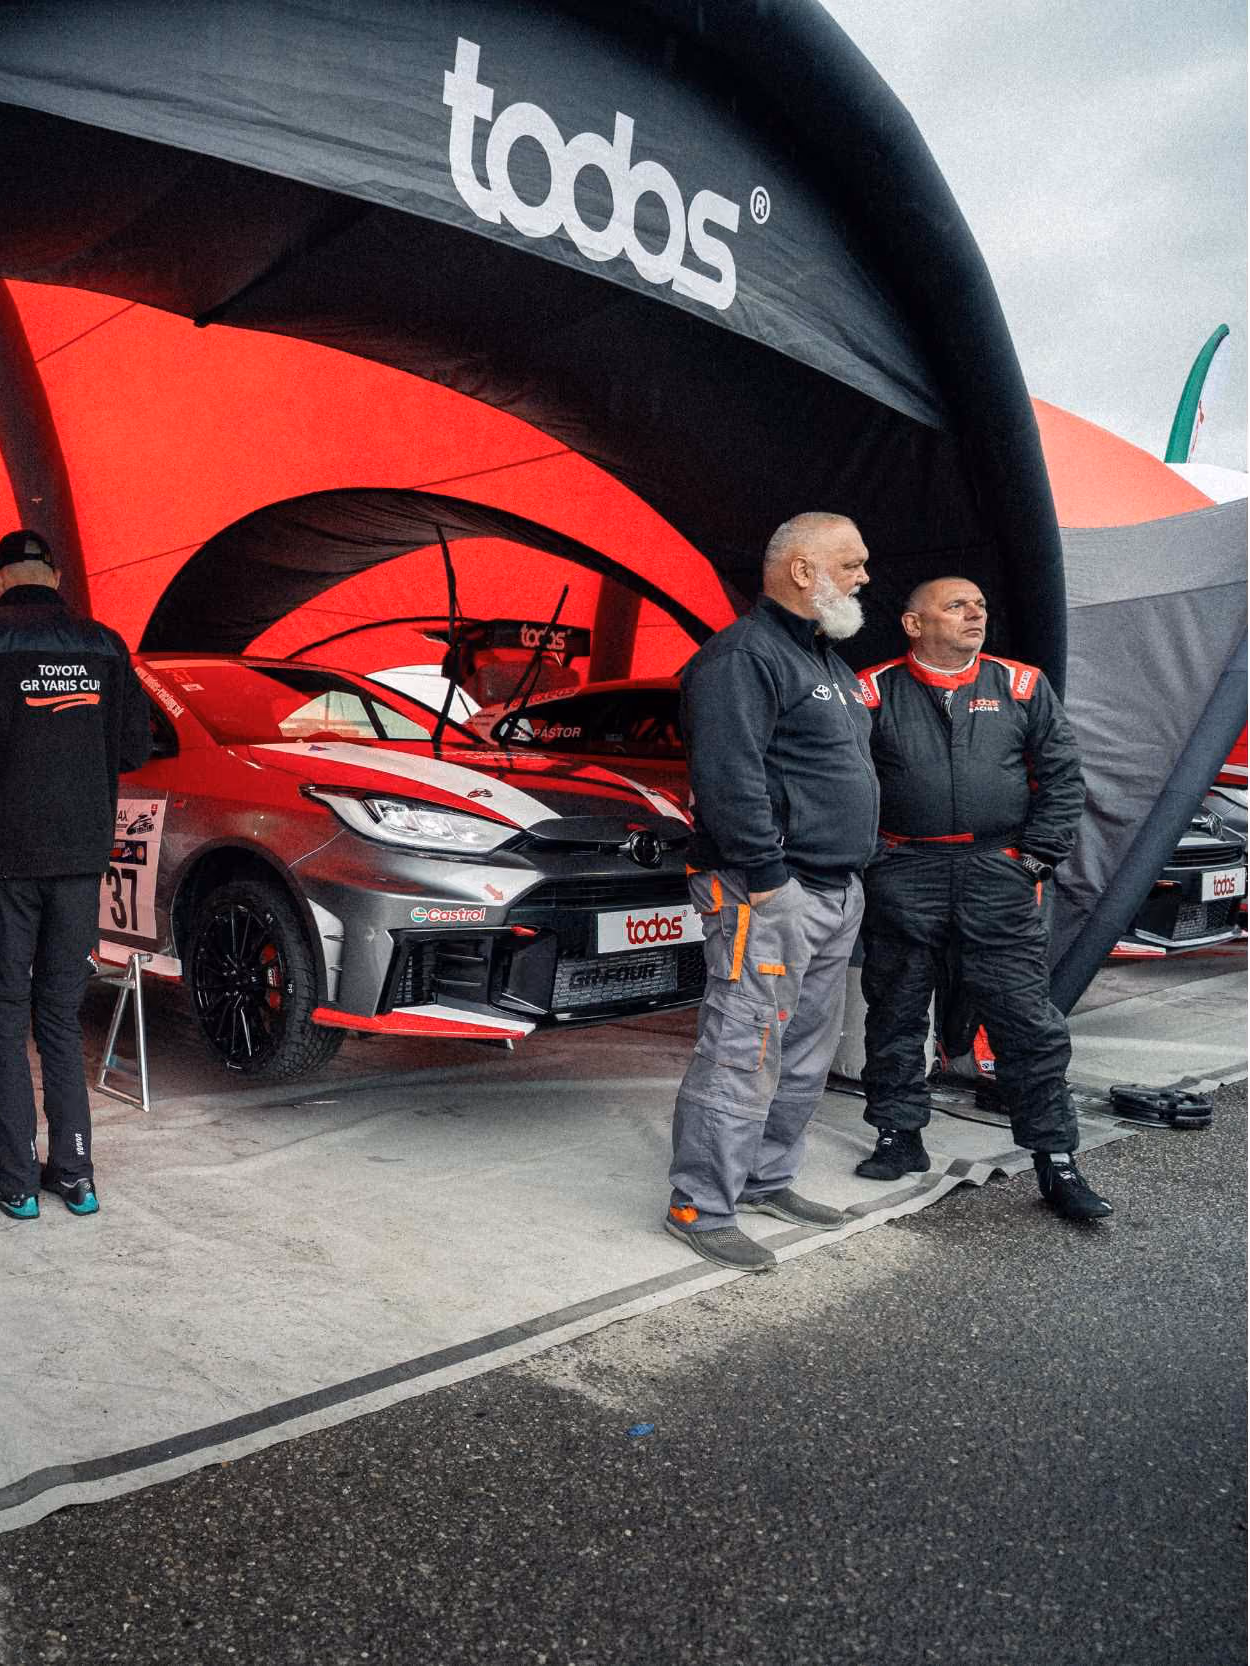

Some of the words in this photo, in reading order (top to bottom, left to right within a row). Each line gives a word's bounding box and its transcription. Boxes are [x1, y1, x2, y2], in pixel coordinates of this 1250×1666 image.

[38, 665, 88, 676] TOYOTA
[20, 679, 39, 692] GR
[42, 679, 77, 692] YARIS
[106, 865, 138, 931] 37
[428, 907, 487, 922] Castrol
